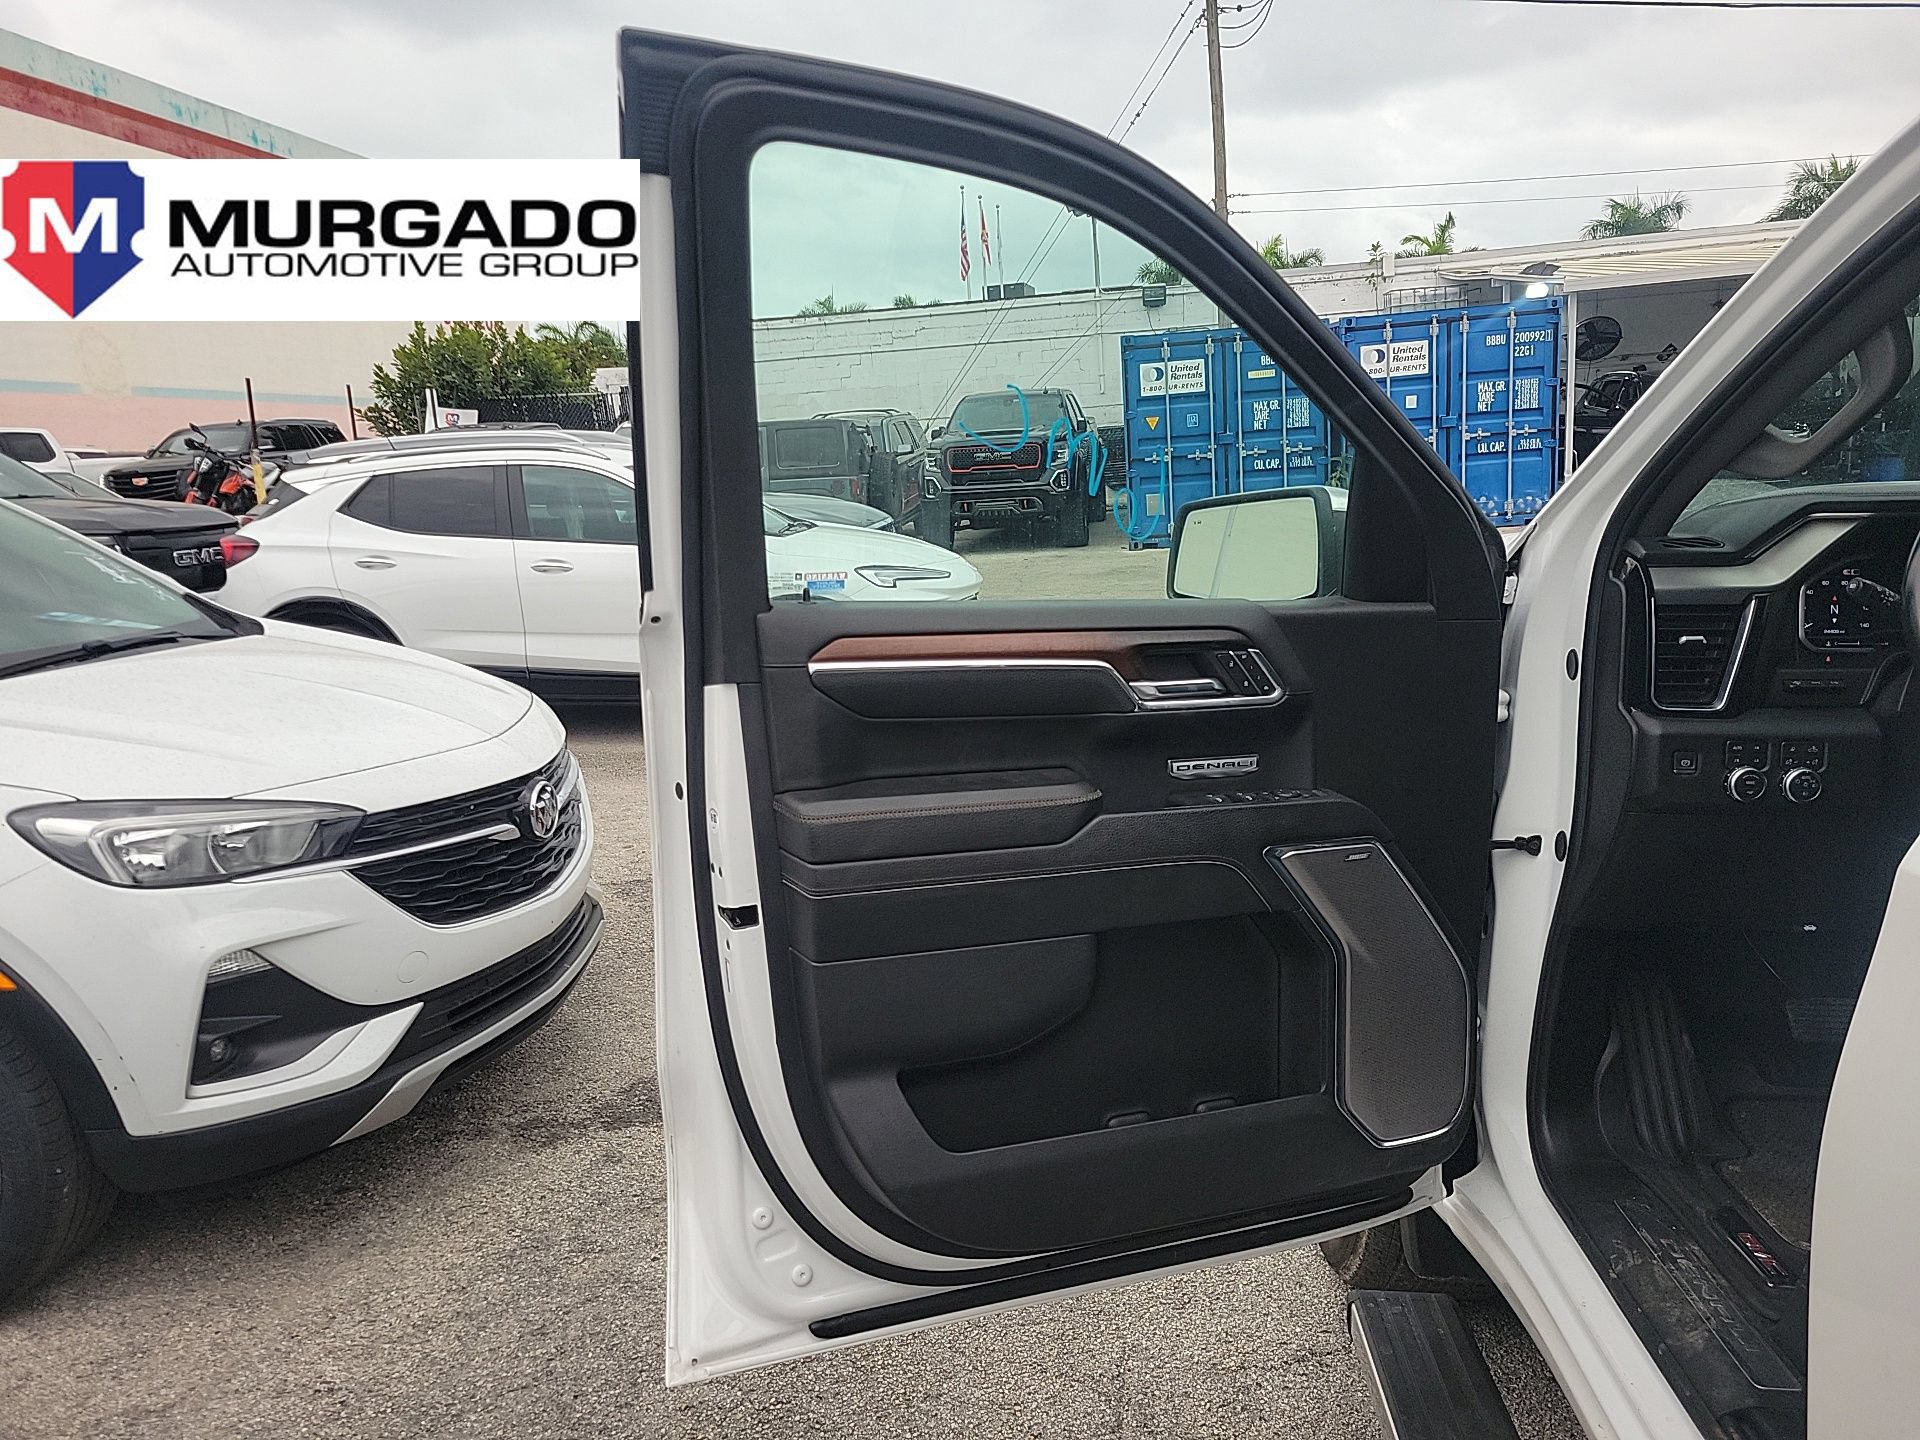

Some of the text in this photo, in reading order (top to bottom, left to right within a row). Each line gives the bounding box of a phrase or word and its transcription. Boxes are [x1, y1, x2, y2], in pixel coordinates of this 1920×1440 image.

[1392, 345, 1424, 354] United
[1515, 345, 1534, 356] 22G1
[1392, 353, 1427, 363] Rentals
[1170, 363, 1201, 372] United
[1170, 371, 1203, 381] Rentals
[1478, 391, 1495, 402] TARE
[1477, 401, 1492, 412] NET
[1254, 410, 1270, 421] TARE
[1253, 420, 1267, 431] NET
[173, 546, 225, 567] GMC
[1830, 604, 1839, 615] N
[1176, 760, 1254, 772] DENALI
